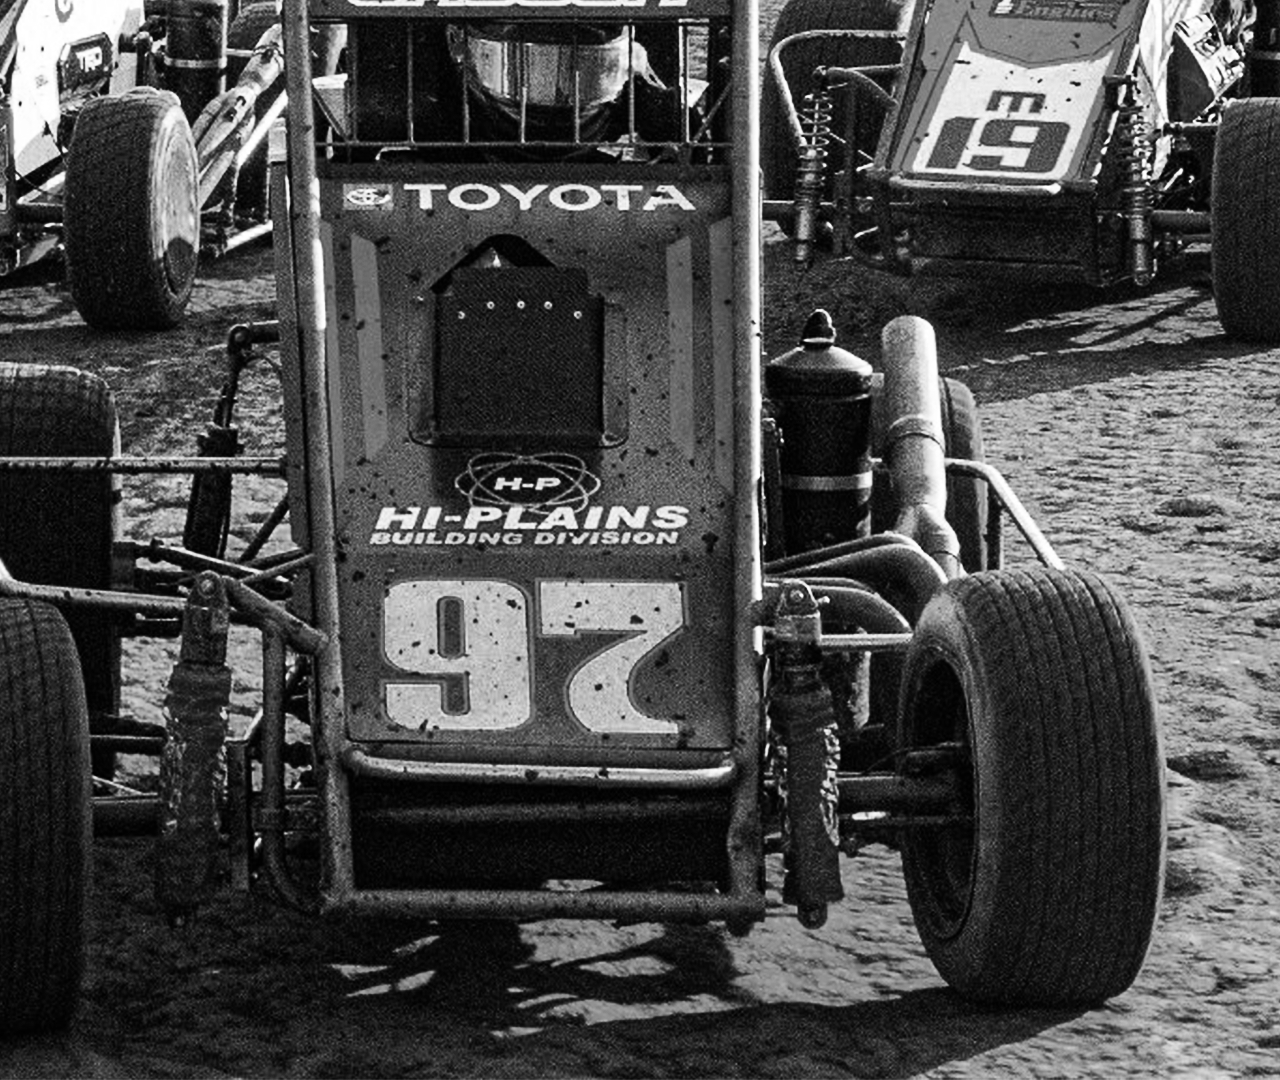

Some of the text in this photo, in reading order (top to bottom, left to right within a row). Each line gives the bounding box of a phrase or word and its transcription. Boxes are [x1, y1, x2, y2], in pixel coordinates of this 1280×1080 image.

[926, 116, 1071, 173] 19
[403, 183, 697, 211] TOYOTA
[494, 477, 562, 491] H-P
[375, 505, 690, 531] HI-PLAINS
[369, 531, 679, 545] BUILDING DIVISION
[383, 579, 686, 735] 97
